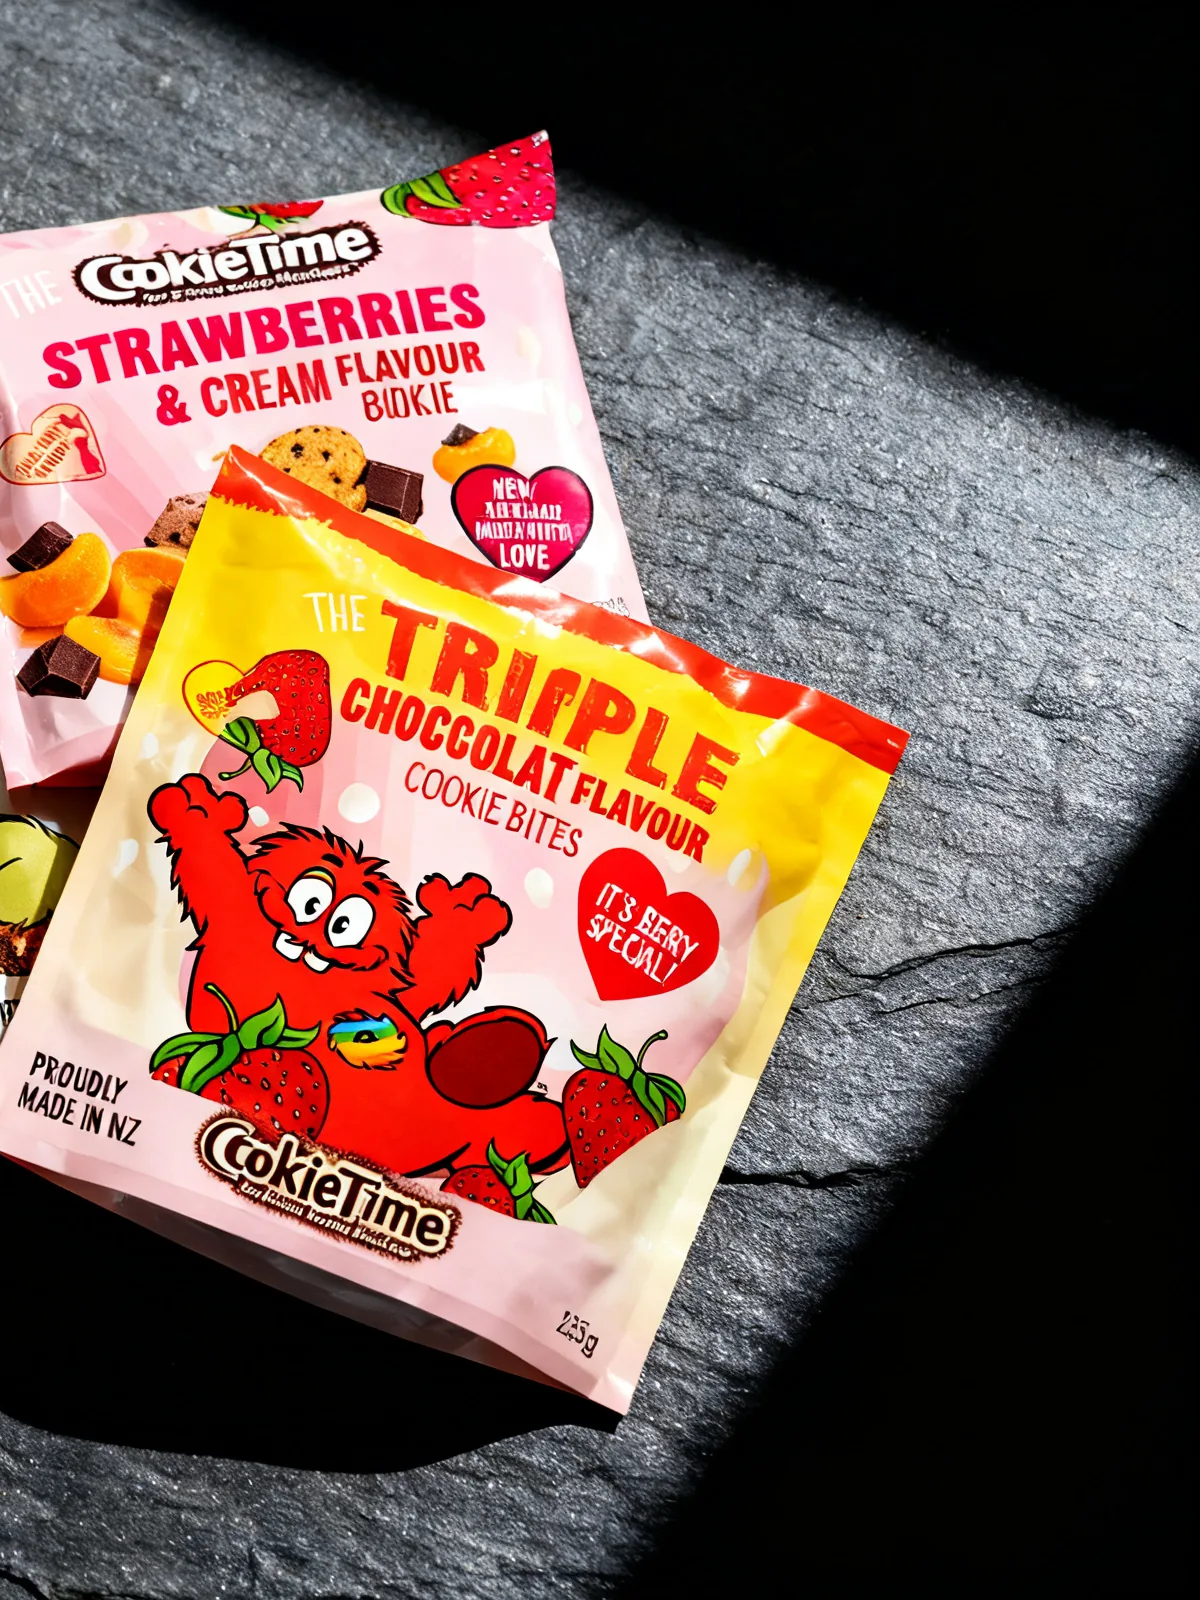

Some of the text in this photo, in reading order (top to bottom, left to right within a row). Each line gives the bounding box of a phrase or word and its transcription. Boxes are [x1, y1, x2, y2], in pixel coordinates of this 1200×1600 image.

[79, 227, 372, 301] CookieTime
[42, 283, 487, 389] STRAWBERRIES
[155, 341, 486, 426] & CREAM FLAVOUR
[493, 477, 537, 500] NEW
[500, 543, 550, 570] LOVE
[303, 592, 368, 632] THE
[340, 677, 711, 864] CHOCCOLAT FLAVOUR
[404, 761, 584, 858] COOKIE BITES
[17, 1081, 142, 1147] MADE IN NZ
[29, 1051, 129, 1105] PROUDLY
[200, 1117, 450, 1254] CookieTime
